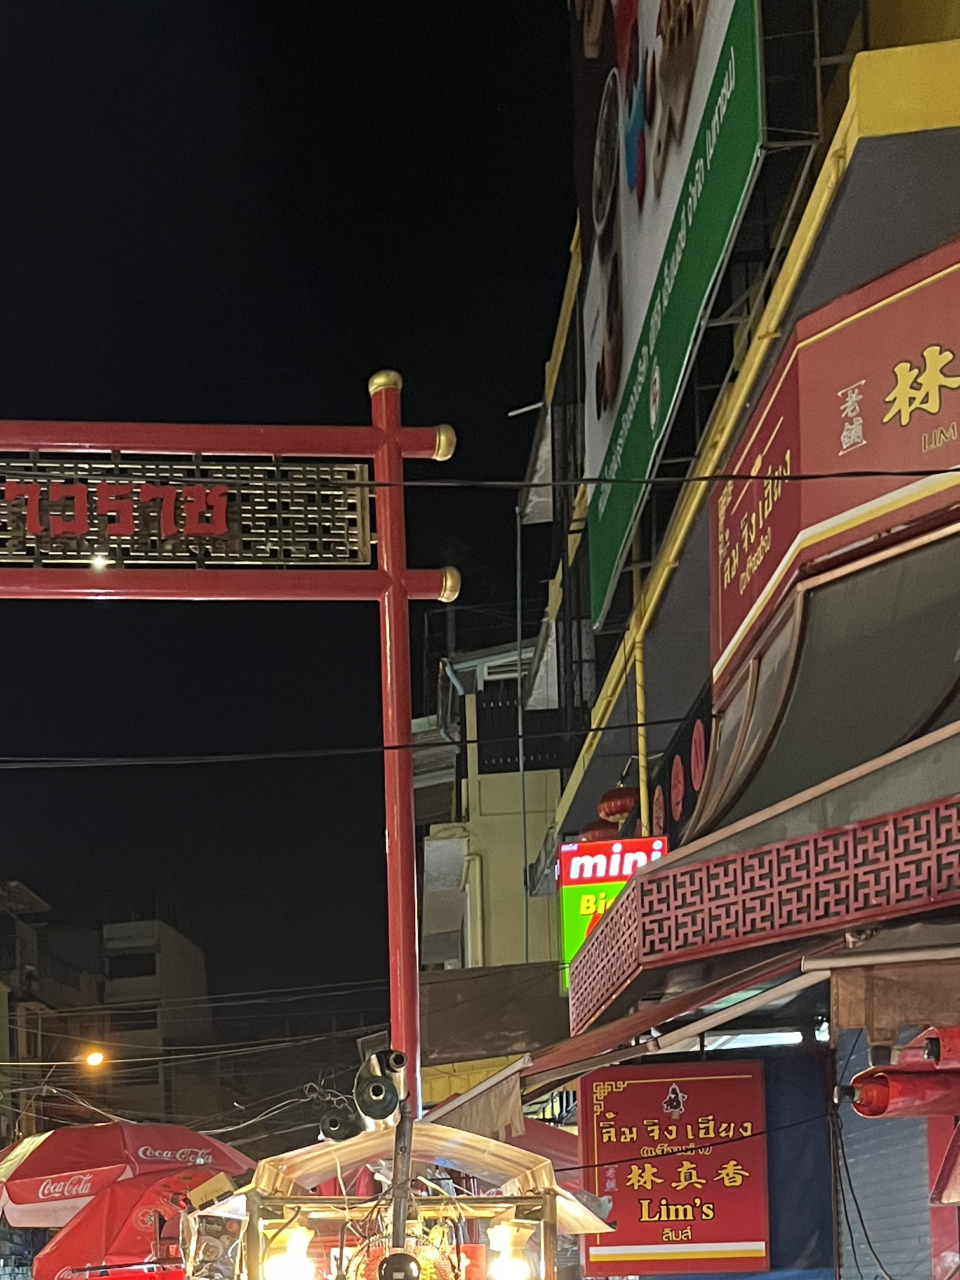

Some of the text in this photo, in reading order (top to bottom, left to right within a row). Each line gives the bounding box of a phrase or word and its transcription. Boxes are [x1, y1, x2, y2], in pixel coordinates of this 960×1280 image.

[570, 840, 663, 879] mini
[580, 892, 616, 915] Bi
[599, 1112, 638, 1143] ลิ้ม
[643, 1119, 677, 1141] จิง
[138, 1146, 214, 1164] Coca-Cola
[39, 1173, 93, 1199] Coca-Cola
[625, 1160, 750, 1190] 林真香
[639, 1198, 715, 1221] Lim's
